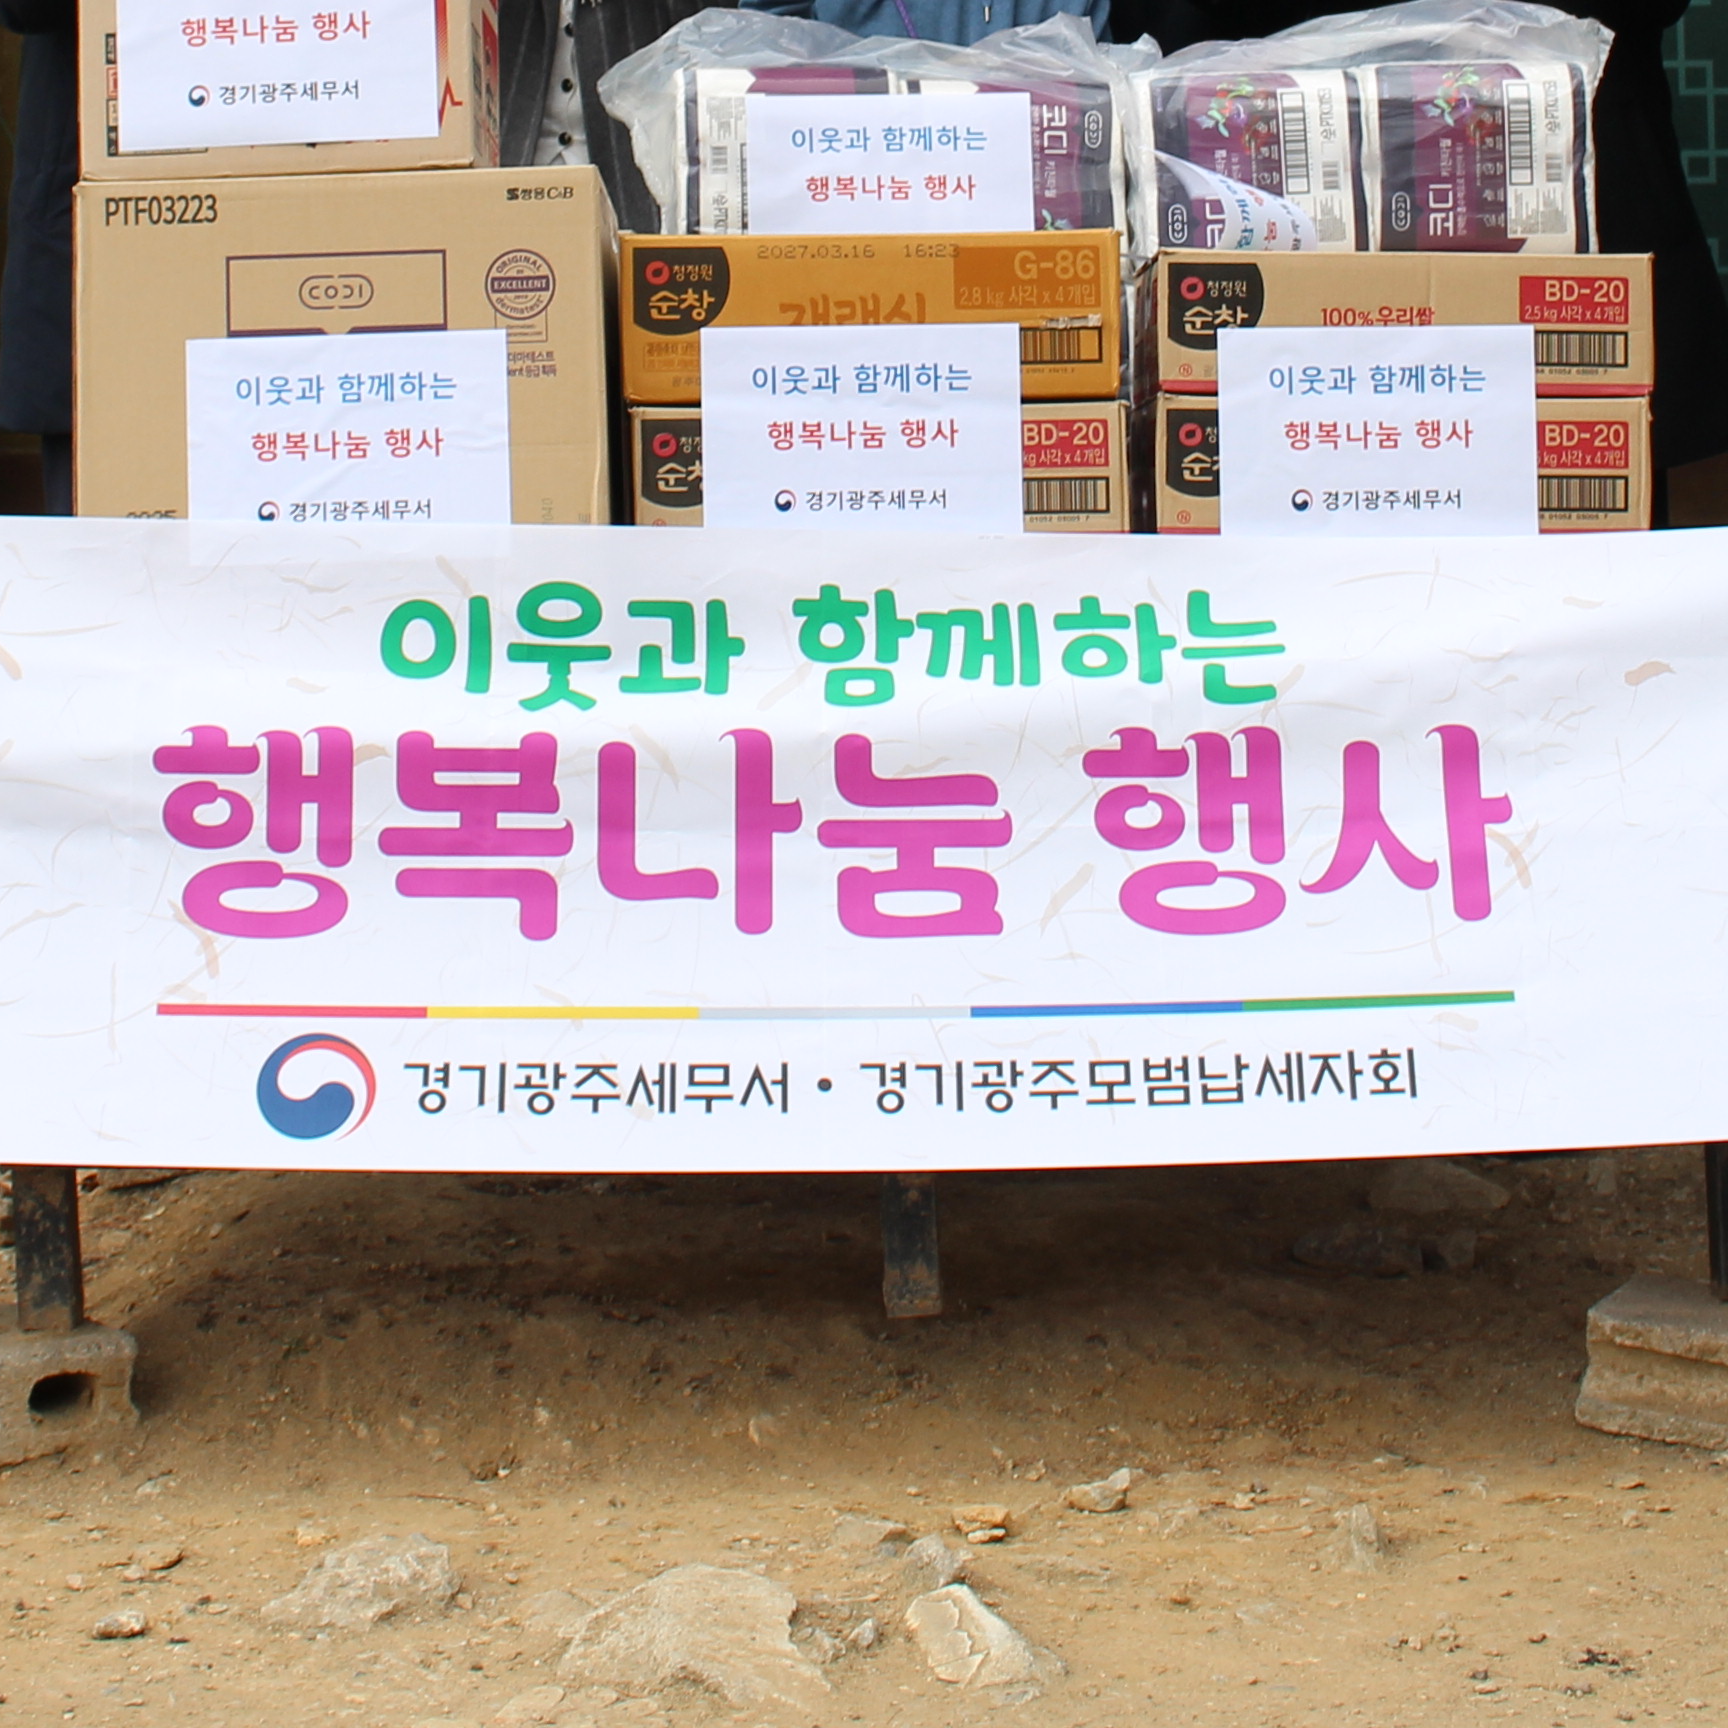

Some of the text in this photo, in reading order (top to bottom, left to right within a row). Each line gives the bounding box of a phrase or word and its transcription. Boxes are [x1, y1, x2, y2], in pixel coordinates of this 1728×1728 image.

[181, 10, 371, 48] 행복나눔 행사
[218, 79, 360, 105] 경기광주세무서
[790, 124, 988, 153] 이웃과 함께하는
[805, 174, 977, 202] 행복나눔 행사
[104, 194, 218, 227] PTF03223
[1428, 184, 1454, 237] 코디
[495, 254, 543, 274] ORIGINAL
[757, 243, 961, 259] 2027.03.16 16:23
[1014, 249, 1095, 280] G-86
[493, 278, 547, 290] EXCELLENT
[672, 264, 713, 282] 청정원
[959, 287, 982, 306] 2.8
[986, 286, 1004, 307] kg
[1008, 284, 1037, 306] 사각
[1042, 291, 1051, 303] x
[1207, 280, 1247, 298] 청정원
[1545, 280, 1625, 302] BD-20
[495, 294, 544, 315] dermatest
[648, 287, 716, 321] 순창
[1544, 305, 1558, 321] kg
[1560, 305, 1582, 321] 사각
[1585, 310, 1592, 320] x
[1182, 303, 1249, 335] 순창
[235, 370, 458, 407] 이웃과 함께하는
[751, 364, 973, 395] 이웃과 함께하는
[1267, 364, 1487, 395] 이웃과 함께하는
[251, 427, 444, 462] 행복나눔 행사
[766, 418, 960, 450] 행복나눔 행사
[1023, 422, 1105, 445] BD-20
[1284, 419, 1475, 451] 행복나눔 행사
[1545, 424, 1625, 447] BD-20
[1039, 449, 1061, 465] 사각
[1064, 453, 1072, 464] x
[1544, 451, 1558, 467] kg
[1560, 450, 1582, 467] 사각
[1585, 455, 1592, 465] x
[288, 498, 432, 522] 경기광주세무서
[804, 488, 948, 512] 경기광주세무서
[1321, 488, 1463, 512] 경기광주세무서
[380, 581, 1286, 711] 이웃과 함께하는
[153, 724, 1513, 941] 행복나눔 행사
[403, 1047, 1418, 1114] 경기광주세무서 경기광주모범납세자회
